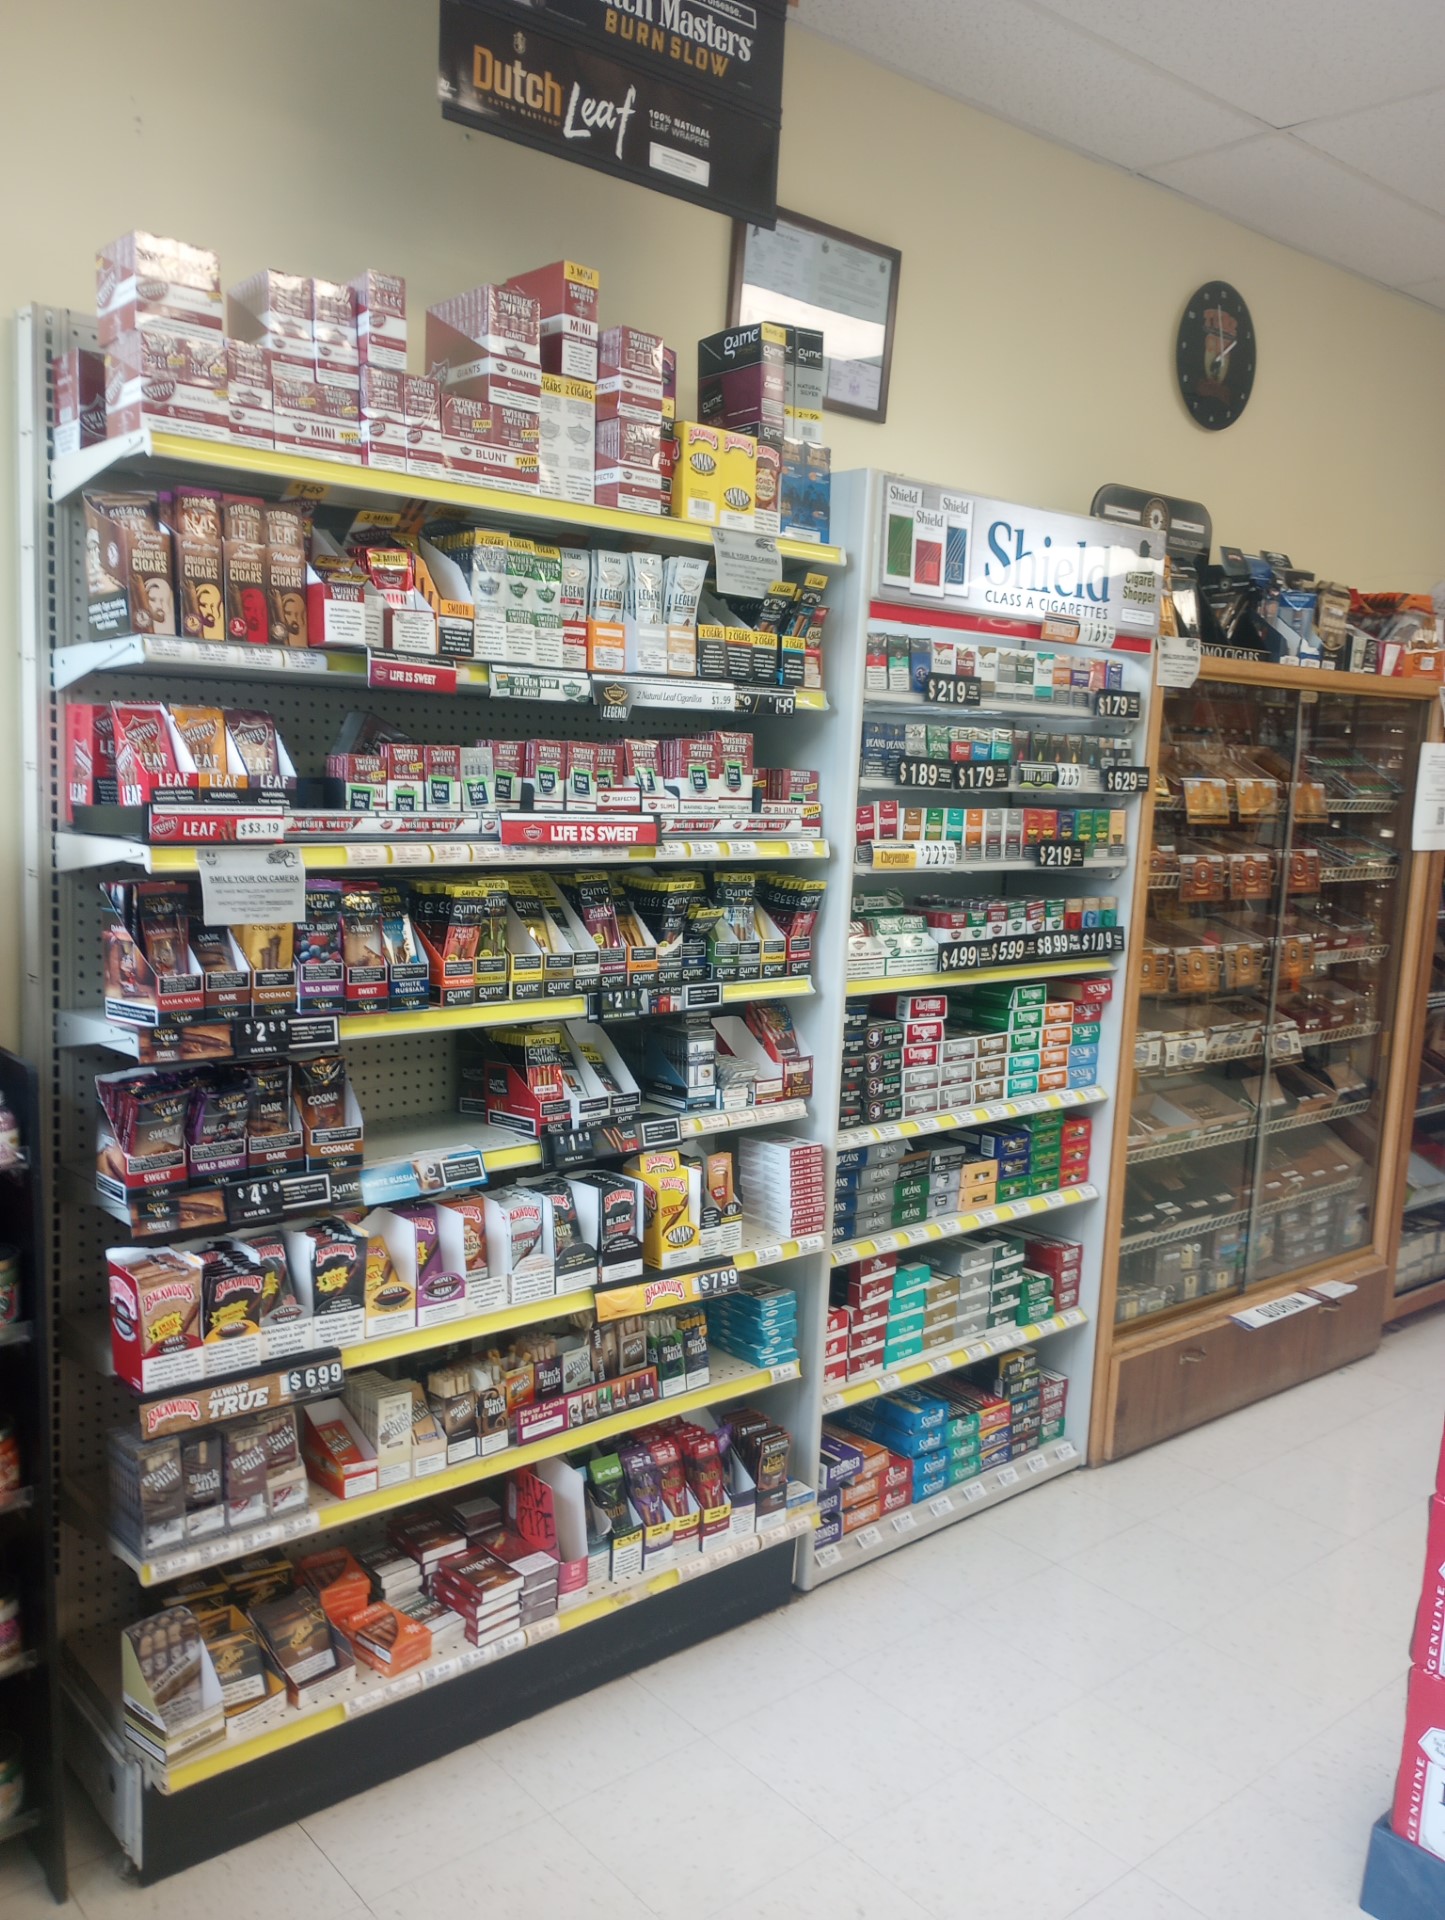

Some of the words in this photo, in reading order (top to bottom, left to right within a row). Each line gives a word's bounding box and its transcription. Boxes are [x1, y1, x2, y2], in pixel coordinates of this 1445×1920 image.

[658, 0, 752, 62] Masters
[605, 8, 665, 53] BURN
[670, 36, 730, 78] SLOW
[473, 44, 563, 117] Dutch
[563, 80, 636, 160] Leaf
[648, 109, 672, 124] 100%
[674, 119, 711, 139] NATURAL
[649, 120, 670, 135] LEAF
[671, 130, 710, 148] WRAPPER
[498, 291, 532, 308] SWISHER
[569, 319, 592, 336] MINI
[505, 330, 526, 342] GIANTS
[724, 326, 760, 359] game
[799, 347, 822, 362] game
[511, 367, 538, 381] GIANTS
[571, 383, 592, 399] CIGARS
[635, 384, 660, 396] PERFECTO
[311, 425, 336, 440] MINI
[763, 425, 783, 440] game
[476, 449, 508, 464] BLUNT
[515, 456, 537, 466] TWIN
[635, 474, 659, 485] PERFECTO
[889, 485, 918, 504] Shield
[942, 497, 970, 515] Shield
[915, 510, 944, 529] Shield
[231, 521, 259, 542] LEAF
[269, 526, 298, 546] LEAF
[132, 558, 167, 574] CIGARS
[985, 521, 1111, 603] Shield
[184, 563, 218, 580] CIGARS
[229, 568, 262, 584] CIGARS
[271, 573, 301, 588] CIGARS
[330, 585, 359, 596] SWISHER
[561, 585, 585, 598] LEGEND
[600, 588, 623, 601] LEGEND
[675, 592, 697, 606] LEGEND
[985, 590, 1022, 607] CLASS
[1026, 598, 1034, 609] A
[1039, 598, 1109, 620] CIGARETTES
[447, 603, 469, 616] SMOOTH
[707, 629, 723, 640] CIGARS
[733, 631, 750, 643] CIGARS
[759, 636, 776, 647] CIGARS
[389, 671, 404, 682] LIFE
[405, 673, 413, 682] IS
[414, 673, 437, 686] SWEET
[514, 677, 539, 687] GREEN
[540, 679, 557, 688] NOW
[513, 688, 520, 696] IN
[522, 688, 540, 697] MINI
[642, 691, 662, 701] Natural
[663, 692, 674, 702] Leaf
[675, 692, 702, 703] Cigarillos
[711, 696, 731, 706] $1.99
[602, 704, 628, 719] LEGEND
[159, 773, 190, 788] LEAF
[210, 773, 240, 788] LEAF
[260, 775, 290, 789] LEAF
[121, 785, 143, 806] LEAF
[353, 791, 368, 802] SAVE
[774, 806, 798, 815] BLUNT
[803, 805, 820, 815] TWIN
[183, 820, 218, 837] LEAF
[248, 821, 280, 834] $3.19
[550, 825, 576, 842] LIFE
[581, 825, 597, 842] IS
[597, 825, 639, 842] SWEET
[880, 851, 911, 866] Cheyenne
[725, 886, 753, 902] game
[454, 903, 483, 920] game
[575, 977, 597, 992] game
[602, 974, 624, 989] game
[633, 972, 655, 986] game
[259, 991, 291, 999] COGNAC
[394, 986, 425, 994] RUSSIAN
[516, 983, 539, 998] game
[548, 980, 571, 995] game
[447, 989, 471, 1004] game
[260, 1102, 282, 1113] DARK
[320, 1143, 354, 1154] COGNAC
[144, 1172, 170, 1183] SWEET
[390, 1173, 419, 1185] RUSSIAN
[901, 1185, 922, 1197] DEANS
[604, 1190, 635, 1211] BACKWOODS
[606, 1214, 631, 1227] BLACK
[316, 1243, 357, 1266] BACKWOODS
[215, 1274, 263, 1302] BACKWOODS
[644, 1279, 686, 1311] BACKWOODS
[144, 1283, 194, 1313] BACKWOODS
[1254, 1297, 1308, 1319] QUORUM
[662, 1342, 683, 1355] Black
[538, 1367, 561, 1380] Black
[210, 1382, 249, 1400] ALWAYS
[208, 1386, 270, 1419] TRUE
[484, 1396, 506, 1410] Black
[541, 1398, 566, 1412] Look
[147, 1398, 200, 1433] BACKWOODS
[520, 1416, 529, 1426] Is
[531, 1410, 554, 1424] Here
[231, 1443, 265, 1470] Black
[142, 1456, 178, 1486] Black
[1427, 1585, 1445, 1671] GENUINE
[1407, 1756, 1426, 1841] GENUINE
